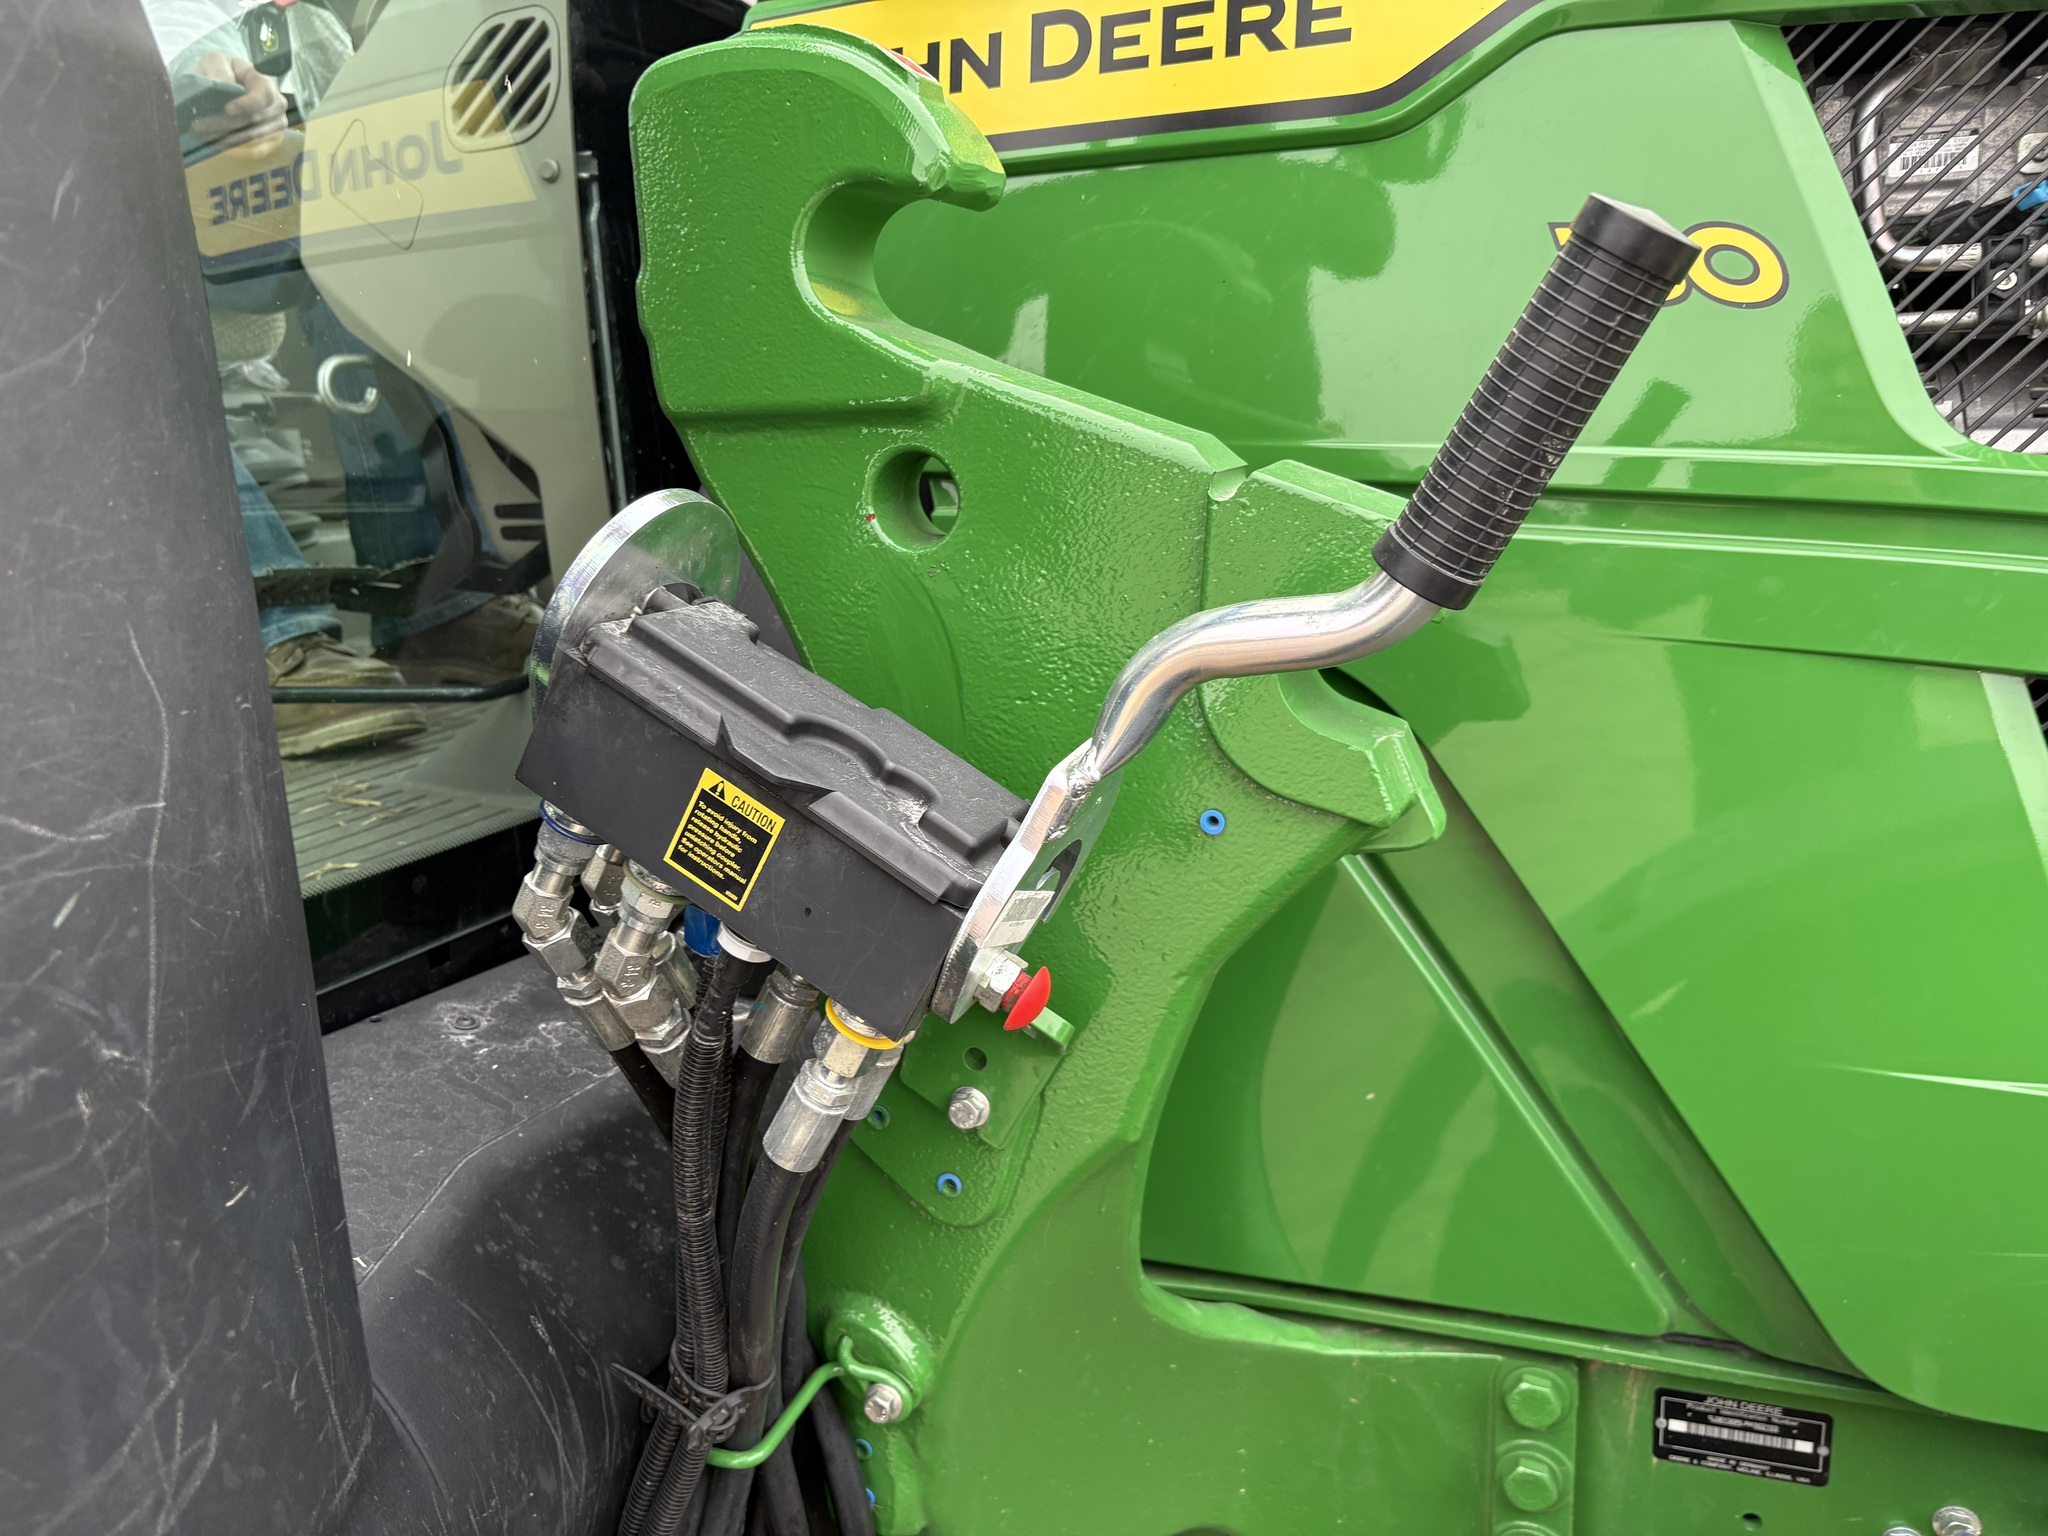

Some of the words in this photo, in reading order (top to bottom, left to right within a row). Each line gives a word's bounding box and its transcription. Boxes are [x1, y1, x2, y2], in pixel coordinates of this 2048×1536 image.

[891, 31, 1002, 95] HN
[1029, 0, 1353, 84] DEERE
[694, 809, 720, 829] rotating
[719, 825, 742, 844] handle,
[698, 800, 707, 809] To
[706, 808, 725, 822] avoid
[724, 818, 742, 834] injury
[742, 830, 758, 845] from
[731, 795, 777, 833] CAUTION
[684, 831, 717, 856] unlatching
[716, 852, 741, 872] coupler.
[687, 823, 715, 844] pressure
[714, 841, 736, 858] before
[691, 816, 714, 834] release
[713, 831, 743, 853] hydraulic
[677, 844, 688, 853] for
[687, 851, 725, 880] instructions.
[681, 837, 694, 849] See
[693, 846, 724, 869] operators
[723, 867, 747, 885] manual
[1703, 1395, 1739, 1408] JOHN
[1741, 1401, 1784, 1416] DEERE
